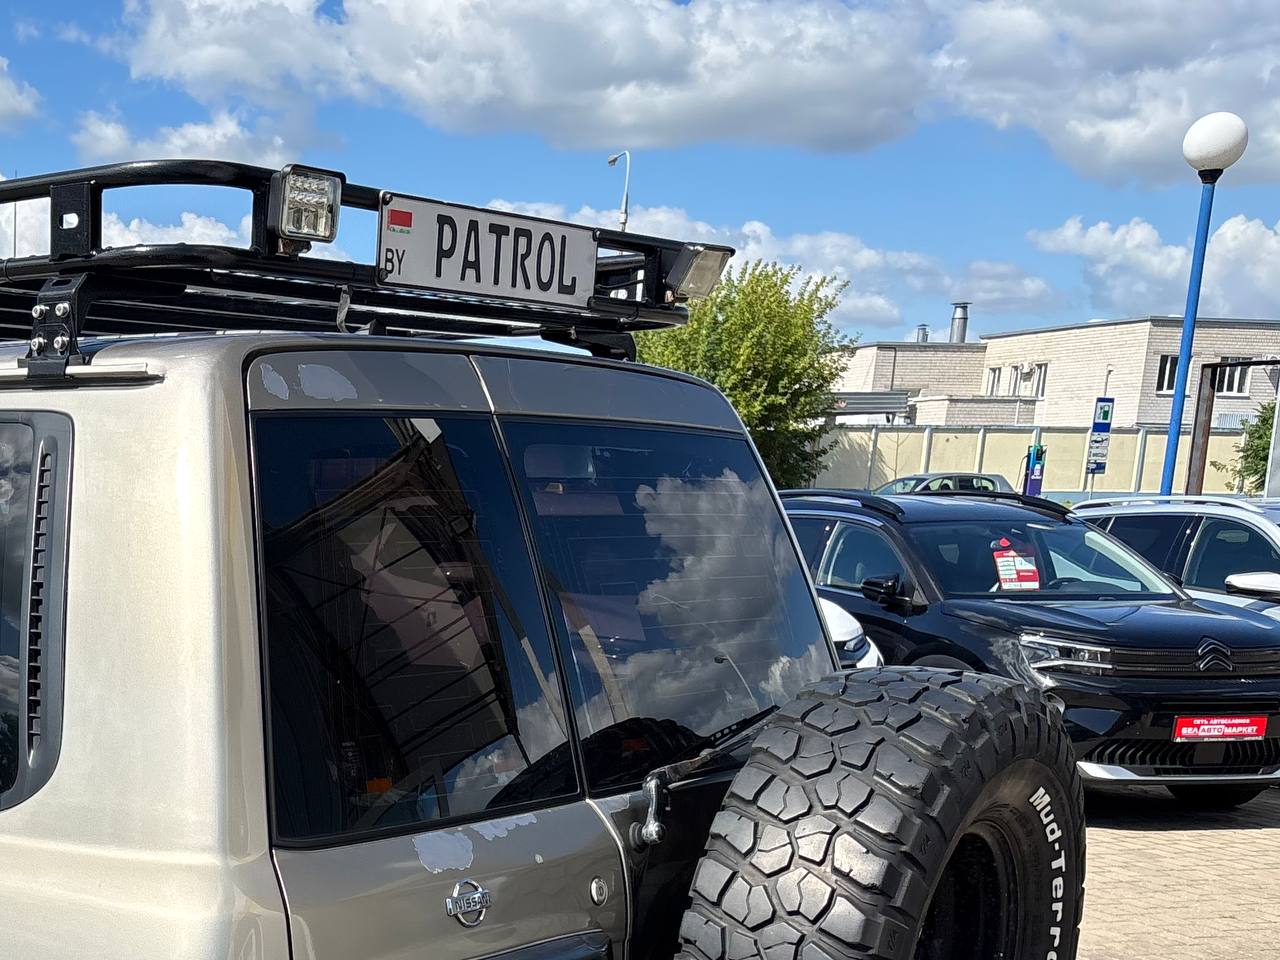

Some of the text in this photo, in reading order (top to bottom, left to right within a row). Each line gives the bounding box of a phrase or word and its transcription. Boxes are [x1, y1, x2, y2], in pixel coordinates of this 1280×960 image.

[384, 247, 406, 275] BY
[435, 213, 577, 295] PATROL
[453, 891, 491, 912] NISSAN
